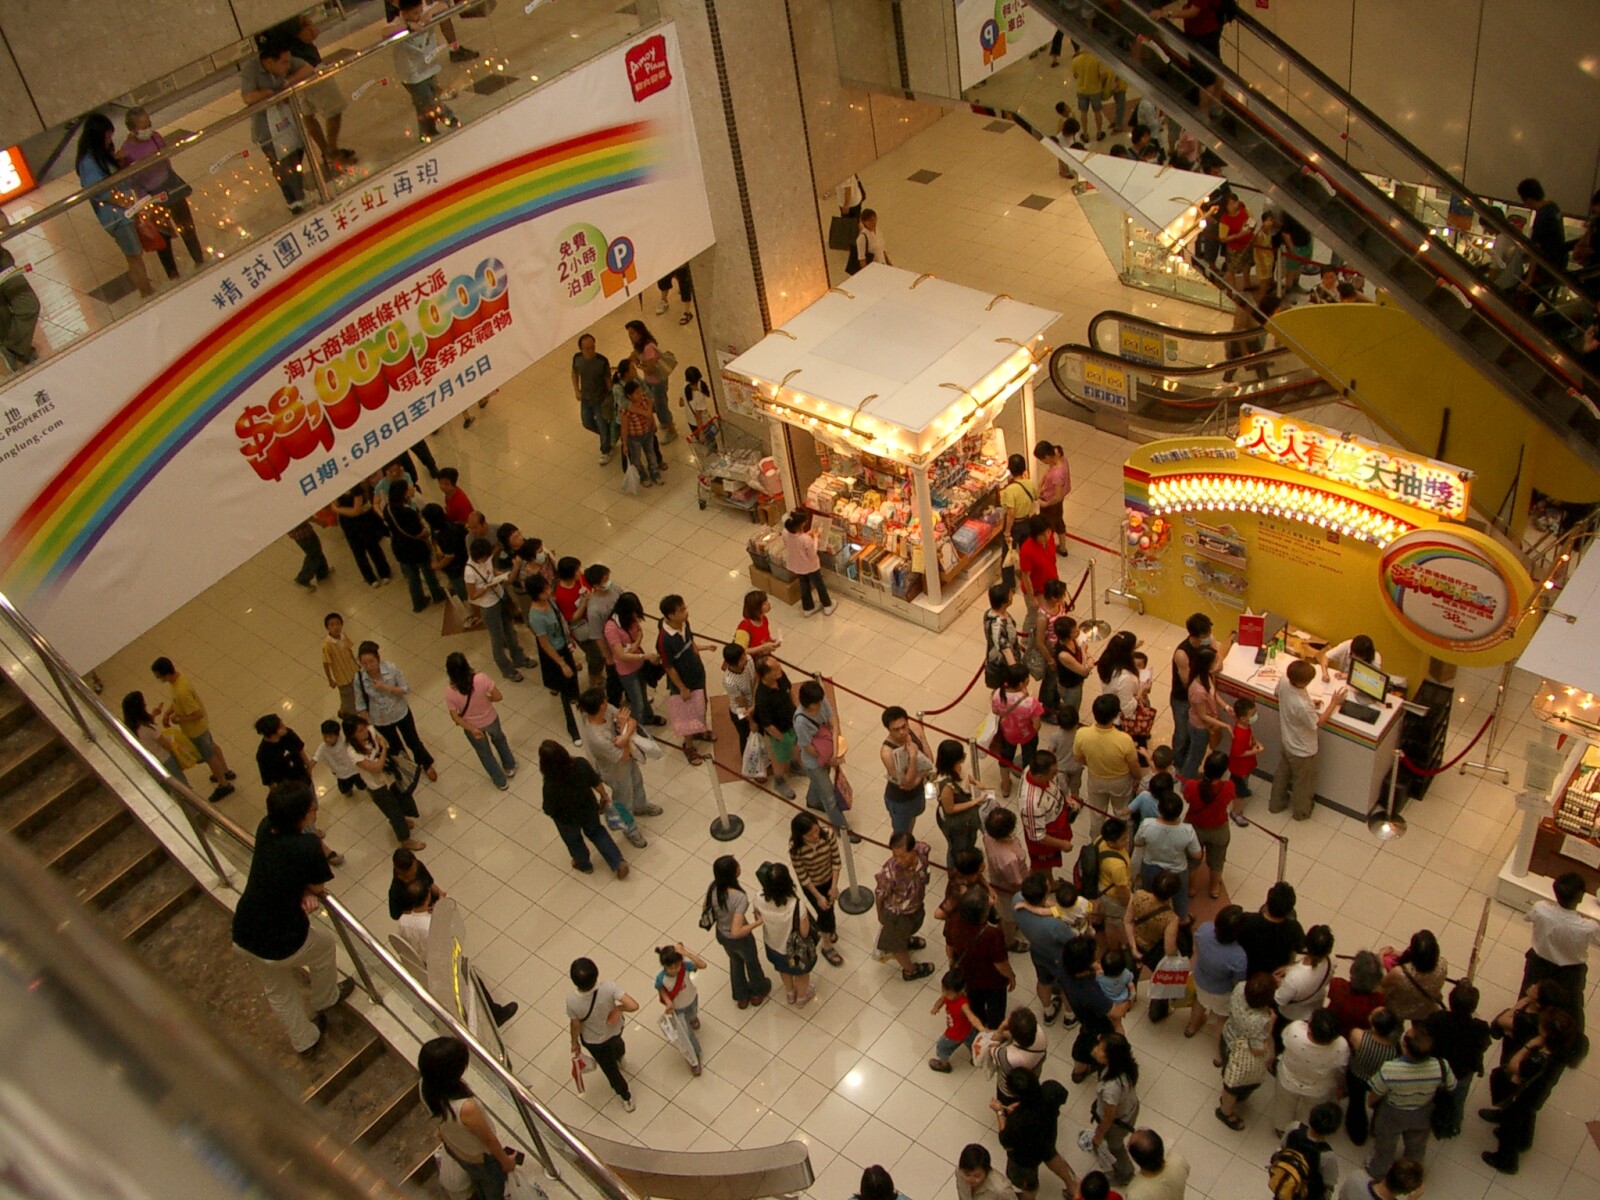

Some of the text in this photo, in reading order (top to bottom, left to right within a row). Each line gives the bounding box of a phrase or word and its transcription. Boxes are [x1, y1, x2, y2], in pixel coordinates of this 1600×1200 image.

[630, 46, 656, 82] Amoy
[212, 158, 439, 310] 精誠團結彩虹再現
[559, 231, 587, 260] 免費
[557, 246, 597, 283] 2小時
[567, 269, 596, 298] 泊車
[284, 268, 448, 384] 淘大商場無條件大派
[234, 257, 510, 482] $8,000,000
[396, 309, 513, 393] 現金券及禮物
[4, 401, 56, 437] PROPERTIES
